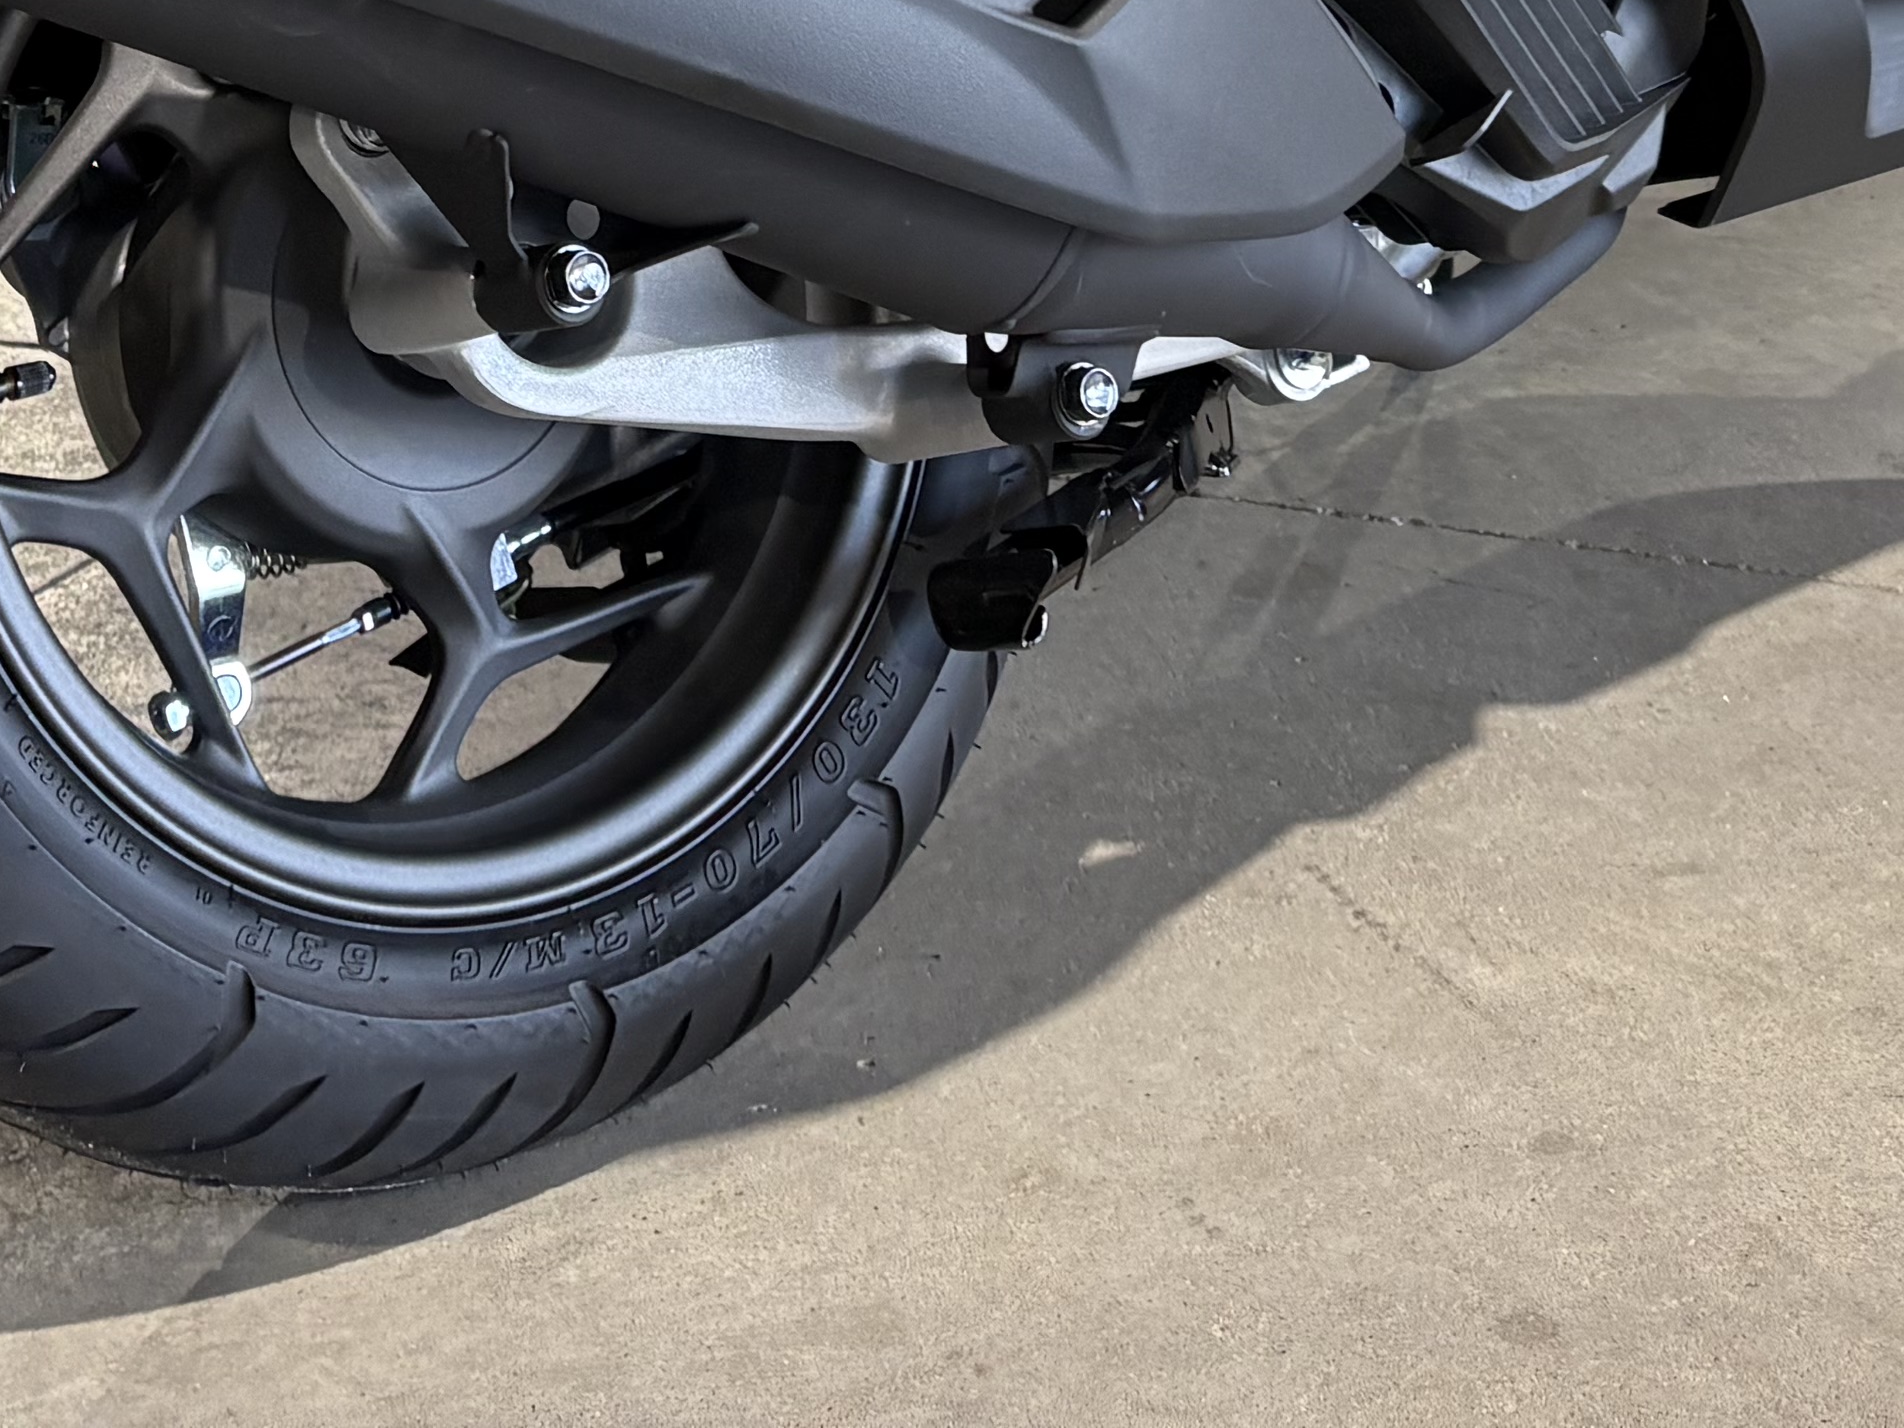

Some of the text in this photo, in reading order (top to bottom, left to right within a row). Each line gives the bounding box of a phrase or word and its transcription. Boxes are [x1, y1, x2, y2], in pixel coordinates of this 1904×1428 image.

[17, 735, 152, 875] REINFORCED
[234, 657, 900, 983] 130/70-13 M/C 63P
